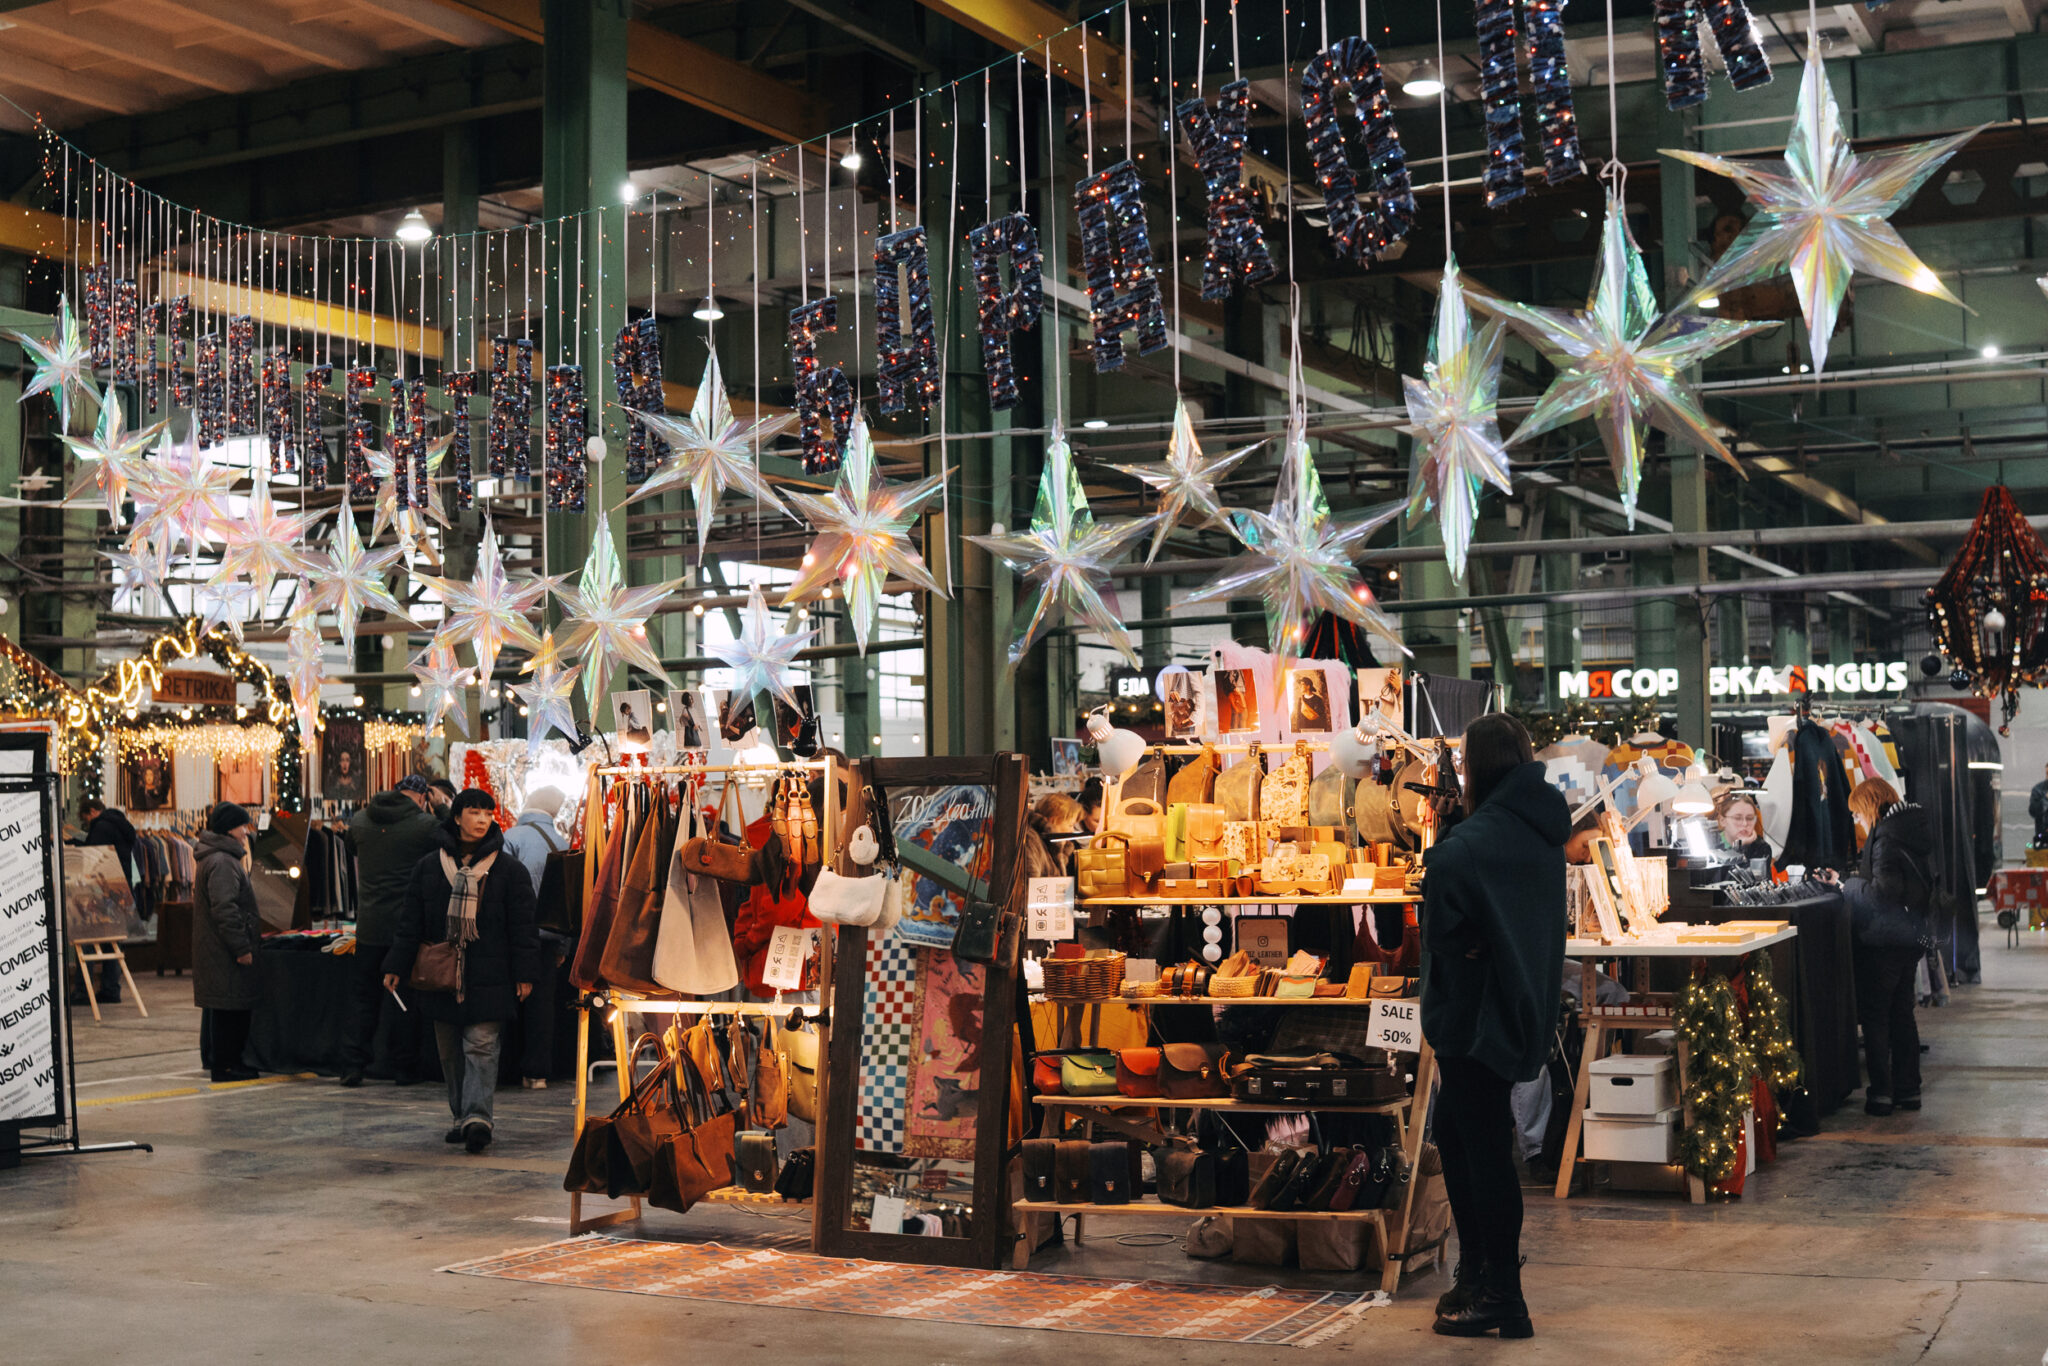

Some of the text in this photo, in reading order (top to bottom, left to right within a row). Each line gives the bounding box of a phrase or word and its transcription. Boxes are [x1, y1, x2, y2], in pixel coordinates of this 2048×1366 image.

[1118, 677, 1150, 697] ЕДА
[1558, 664, 1781, 699] МЯСОРБКА
[1257, 950, 1283, 958] LEATHER
[1380, 1004, 1414, 1021] SALE
[1377, 1028, 1412, 1045] -50%
